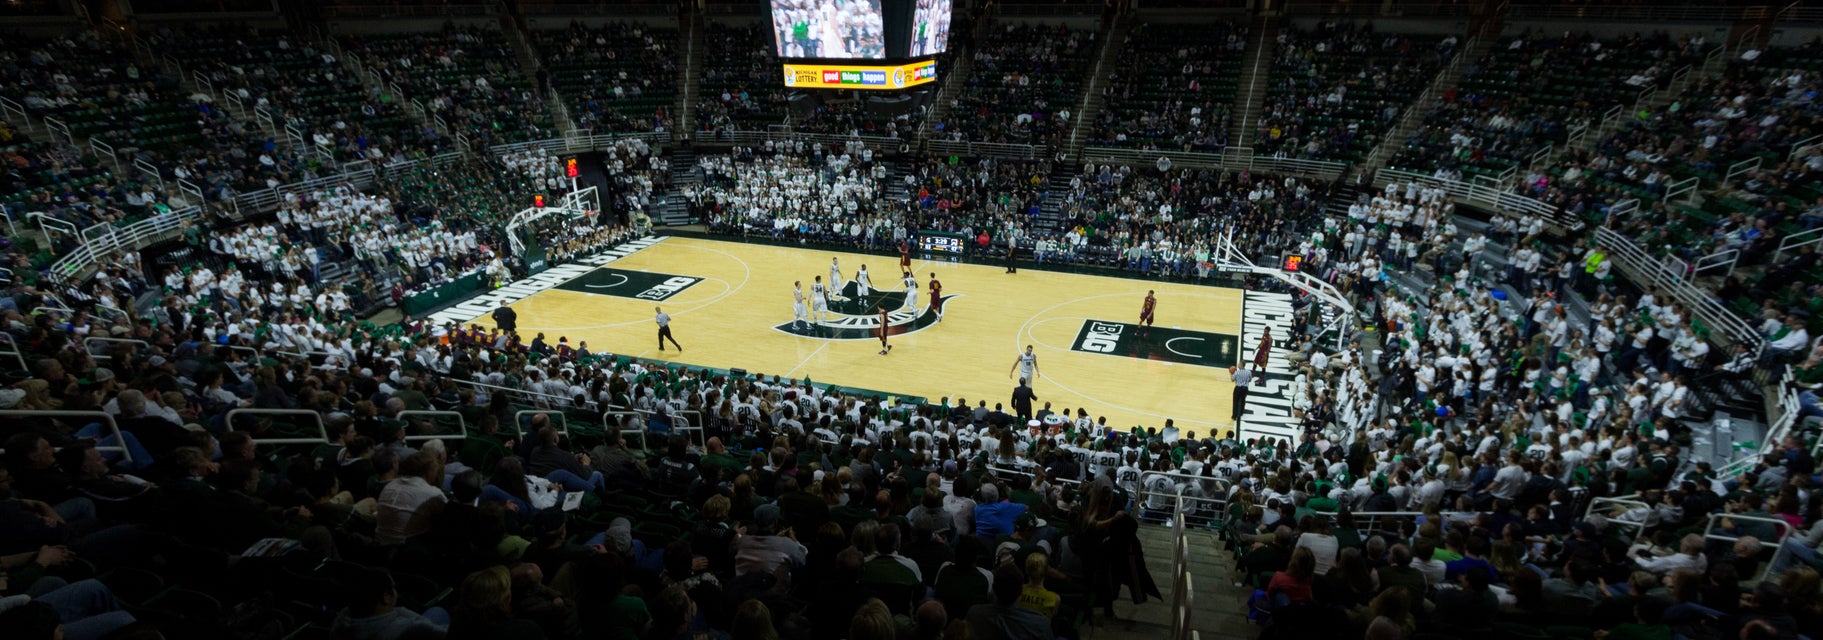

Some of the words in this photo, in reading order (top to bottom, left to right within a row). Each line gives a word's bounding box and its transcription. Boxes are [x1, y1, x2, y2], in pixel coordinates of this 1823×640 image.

[795, 75, 817, 83] LOTTERY
[824, 72, 839, 82] good
[841, 72, 860, 83] things
[862, 71, 885, 83] happen
[426, 263, 598, 325] MICHIGAN
[801, 397, 811, 407] 20
[738, 406, 751, 416] 20
[1073, 452, 1085, 463] 20
[1531, 449, 1545, 460] 20
[1101, 457, 1115, 467] 20
[1123, 471, 1137, 481] 20
[1219, 467, 1232, 477] 20
